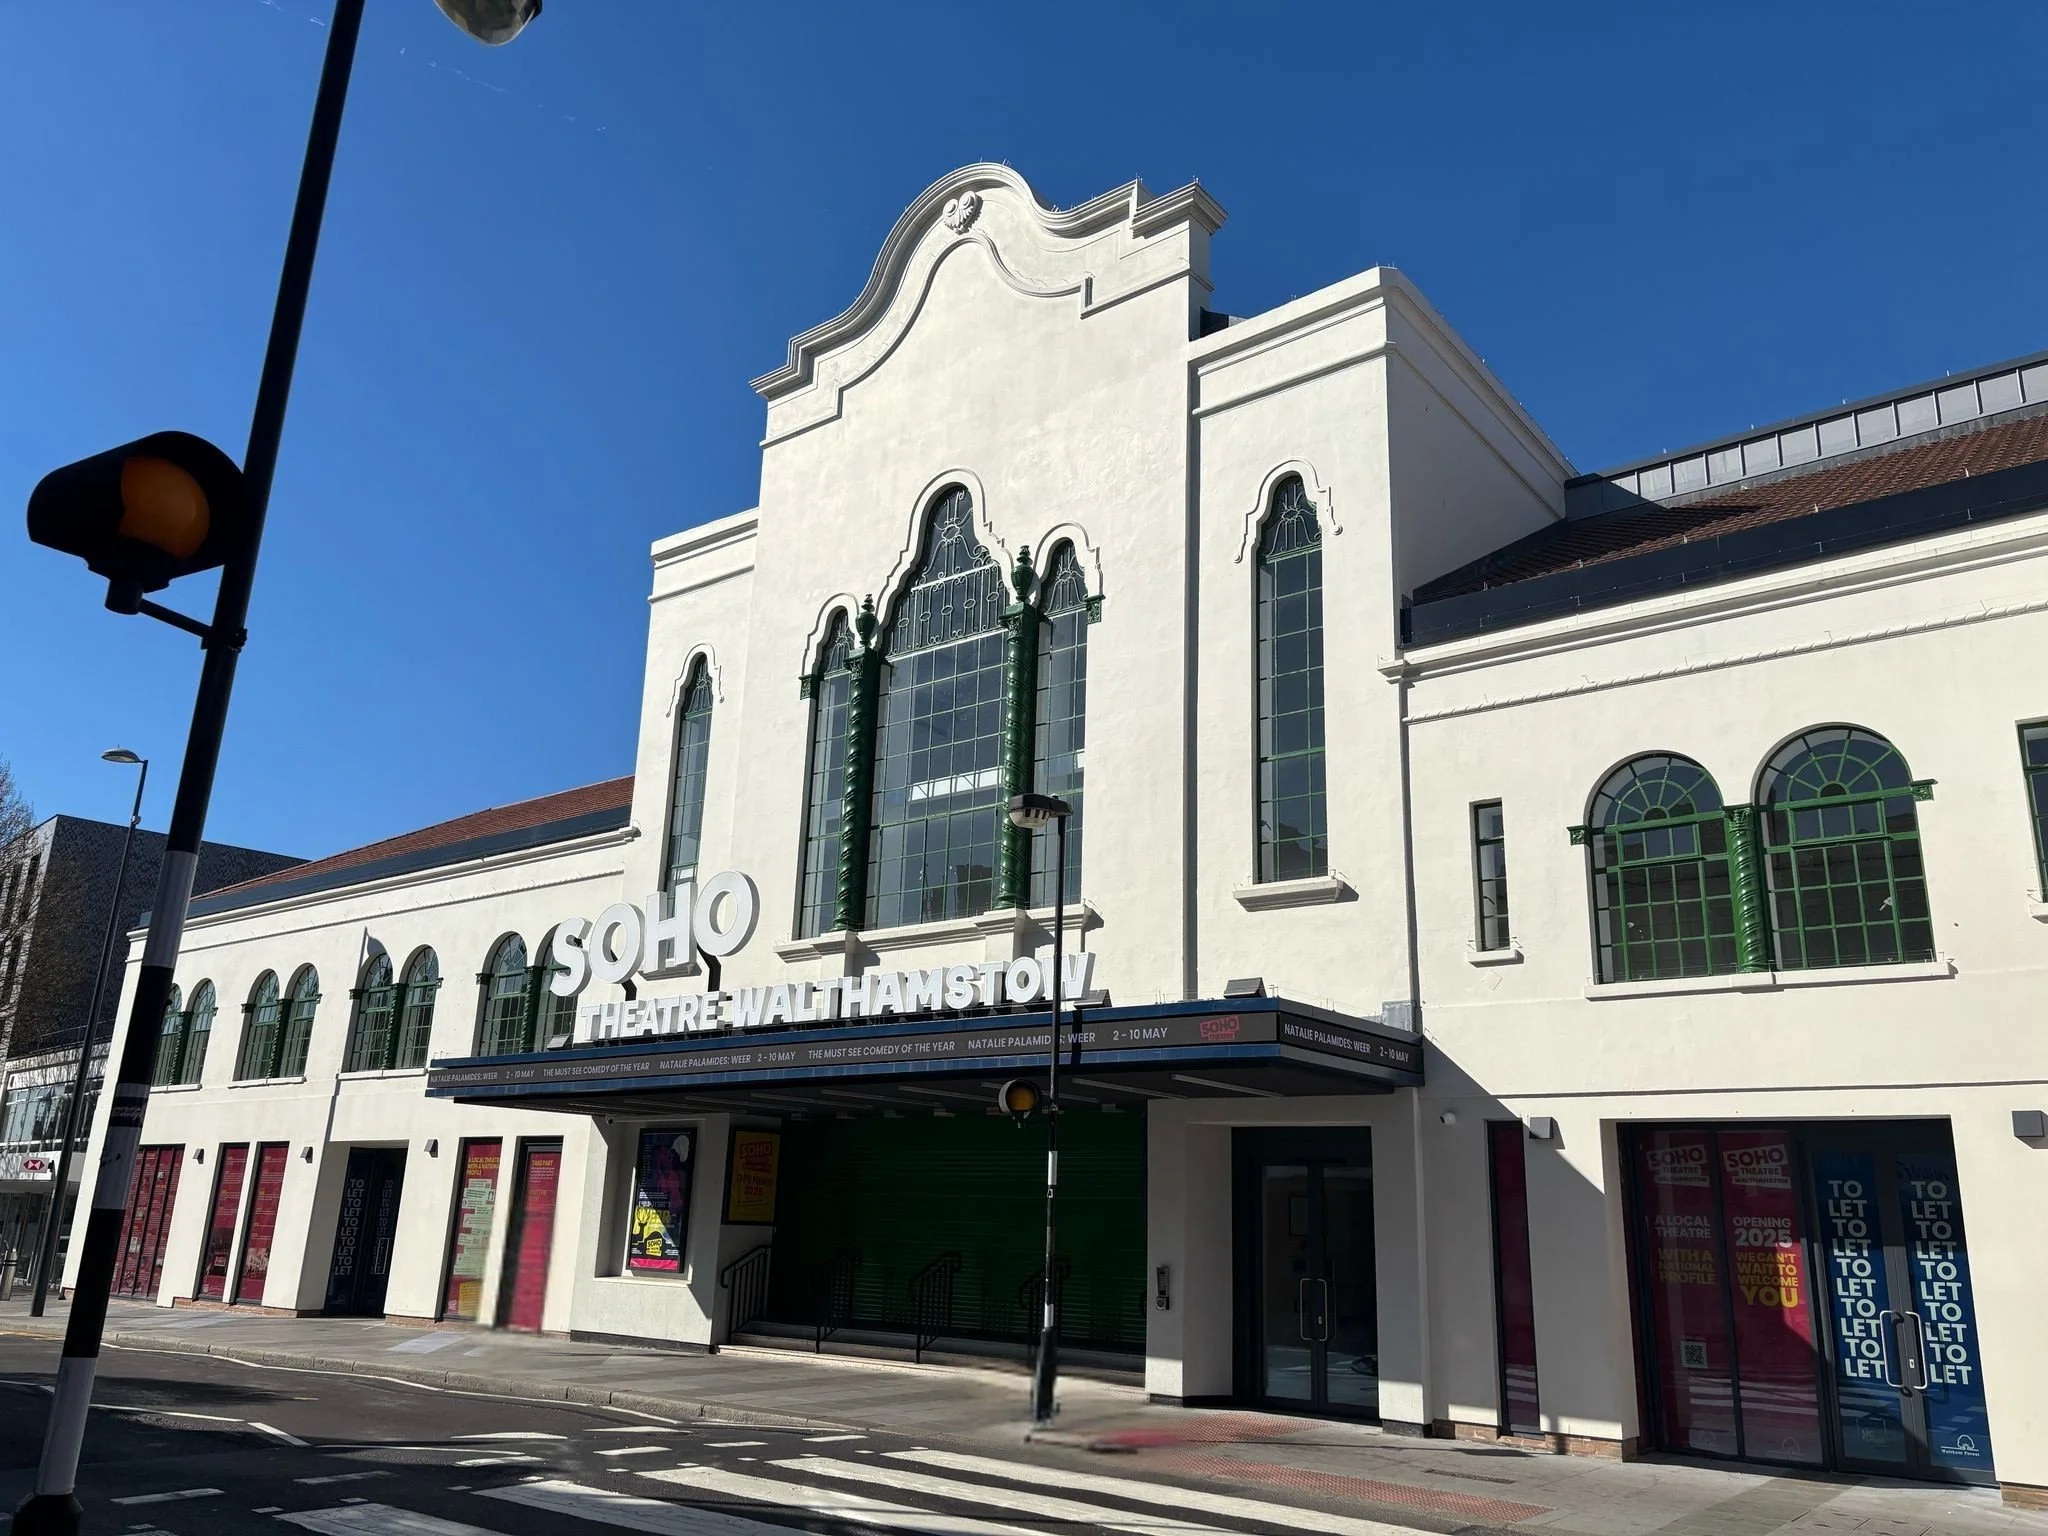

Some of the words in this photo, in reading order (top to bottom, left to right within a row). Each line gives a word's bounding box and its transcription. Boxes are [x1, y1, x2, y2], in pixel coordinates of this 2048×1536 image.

[550, 870, 760, 997] SOHO
[581, 991, 730, 1040] THEATRE
[733, 952, 1095, 1027] WALTHAMSTOW
[1201, 1017, 1238, 1036] SOHO
[968, 1038, 1006, 1049] NATALIE
[1008, 1034, 1065, 1047] PALAMIDS:
[1067, 1032, 1096, 1044] WEER
[1113, 1030, 1119, 1040] 2
[1129, 1029, 1140, 1040] 10
[1142, 1027, 1168, 1039] MAY
[1284, 1024, 1313, 1040] NATALIE
[1314, 1031, 1353, 1050] PALAMIDES:
[1353, 1041, 1371, 1054] WEER
[1380, 1046, 1384, 1056] 2
[1389, 1049, 1395, 1059] 10
[1395, 1051, 1409, 1063] MAY
[808, 1049, 823, 1059] THE
[823, 1048, 847, 1058] MUST
[848, 1047, 862, 1057] SEE
[863, 1045, 900, 1056] COMEDY
[901, 1044, 913, 1054] OF
[914, 1043, 930, 1053] THE
[932, 1041, 956, 1051] YEAR
[543, 1069, 554, 1077] THE
[555, 1067, 571, 1076] MUST
[572, 1066, 582, 1075] SEE
[583, 1064, 610, 1074] COMEDY
[610, 1064, 619, 1073] OF
[620, 1063, 632, 1072] THE
[633, 1062, 650, 1071] YEAR
[660, 1059, 689, 1069] NATALIE
[689, 1056, 730, 1067] PALAMIDES:
[731, 1055, 751, 1065] WEER
[757, 1053, 762, 1062] 2
[769, 1052, 777, 1061] 10
[778, 1051, 796, 1061] MAY
[430, 1075, 451, 1083] NATALIE
[452, 1074, 482, 1082] PALAMIDES:
[483, 1072, 498, 1080] WEER
[515, 1071, 520, 1079] 10
[521, 1070, 535, 1078] MAY
[741, 1142, 771, 1158] SOHO
[1651, 1148, 1703, 1168] SOHO
[1727, 1148, 1784, 1168] SOHO
[1663, 1166, 1698, 1174] THEATRE
[1741, 1167, 1780, 1175] THEATRE
[350, 1179, 365, 1188] TO
[1828, 1180, 1863, 1199] TO
[1911, 1181, 1948, 1200] TO
[347, 1189, 365, 1198] LET
[347, 1198, 361, 1207] TO
[344, 1207, 362, 1217] LET
[1828, 1199, 1867, 1218] LET
[1911, 1201, 1953, 1219] LET
[344, 1217, 359, 1227] TO
[1655, 1215, 1665, 1226] A
[1667, 1215, 1710, 1227] LOCAL
[1732, 1216, 1792, 1228] OPENING
[1832, 1219, 1867, 1238] TO
[1915, 1221, 1953, 1240] TO
[341, 1227, 359, 1236] LET
[1656, 1227, 1712, 1239] THEATRE
[1734, 1228, 1793, 1248] 2025
[337, 1246, 356, 1256] LET
[341, 1237, 356, 1246] TO
[1832, 1238, 1872, 1257] LET
[1916, 1240, 1957, 1260] LET
[338, 1256, 353, 1266] TO
[1658, 1248, 1701, 1261] WITH
[1702, 1250, 1713, 1262] A
[1736, 1252, 1755, 1261] WE
[1755, 1253, 1796, 1263] CAN'T
[334, 1266, 353, 1275] LET
[1659, 1261, 1715, 1272] NATIONAL
[1737, 1263, 1774, 1274] WAIT
[1777, 1264, 1797, 1275] TO
[1836, 1258, 1872, 1277] TO
[1920, 1261, 1957, 1281] TO
[1660, 1271, 1715, 1285] PROFILE
[1738, 1274, 1799, 1287] WELCOME
[1836, 1278, 1876, 1297] LET
[1740, 1286, 1799, 1308] YOU
[1920, 1281, 1962, 1301] LET
[1841, 1298, 1876, 1317] TO
[1924, 1302, 1962, 1322] TO
[1841, 1318, 1880, 1338] LET
[1925, 1322, 1967, 1343] LET
[1845, 1338, 1880, 1358] TO
[1929, 1343, 1967, 1364] TO
[1845, 1358, 1885, 1379] LET
[1929, 1364, 1972, 1385] LET
